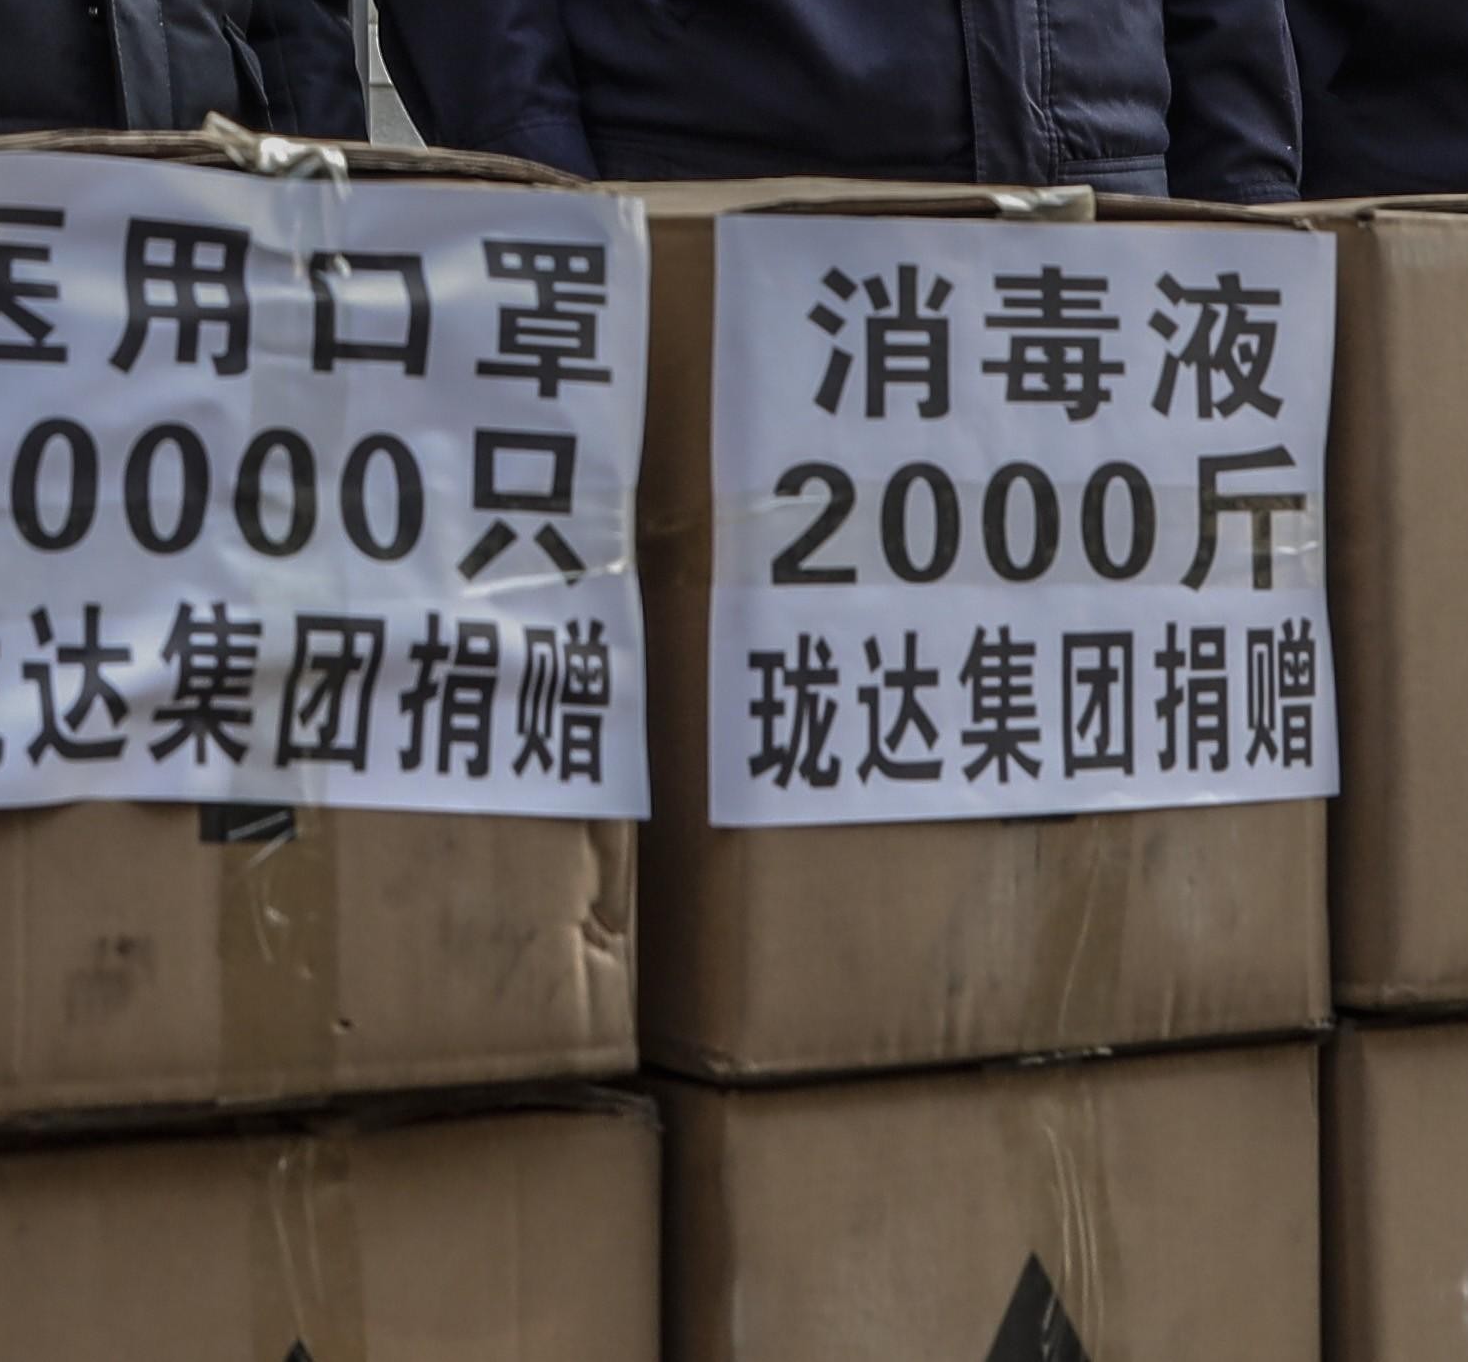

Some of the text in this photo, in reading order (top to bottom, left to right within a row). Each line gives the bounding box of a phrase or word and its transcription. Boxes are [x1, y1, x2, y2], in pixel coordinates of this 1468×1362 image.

[807, 265, 1285, 422] 消毒液
[770, 445, 1307, 591] 2000斤
[748, 618, 1316, 793] 珑达集团捐赠
